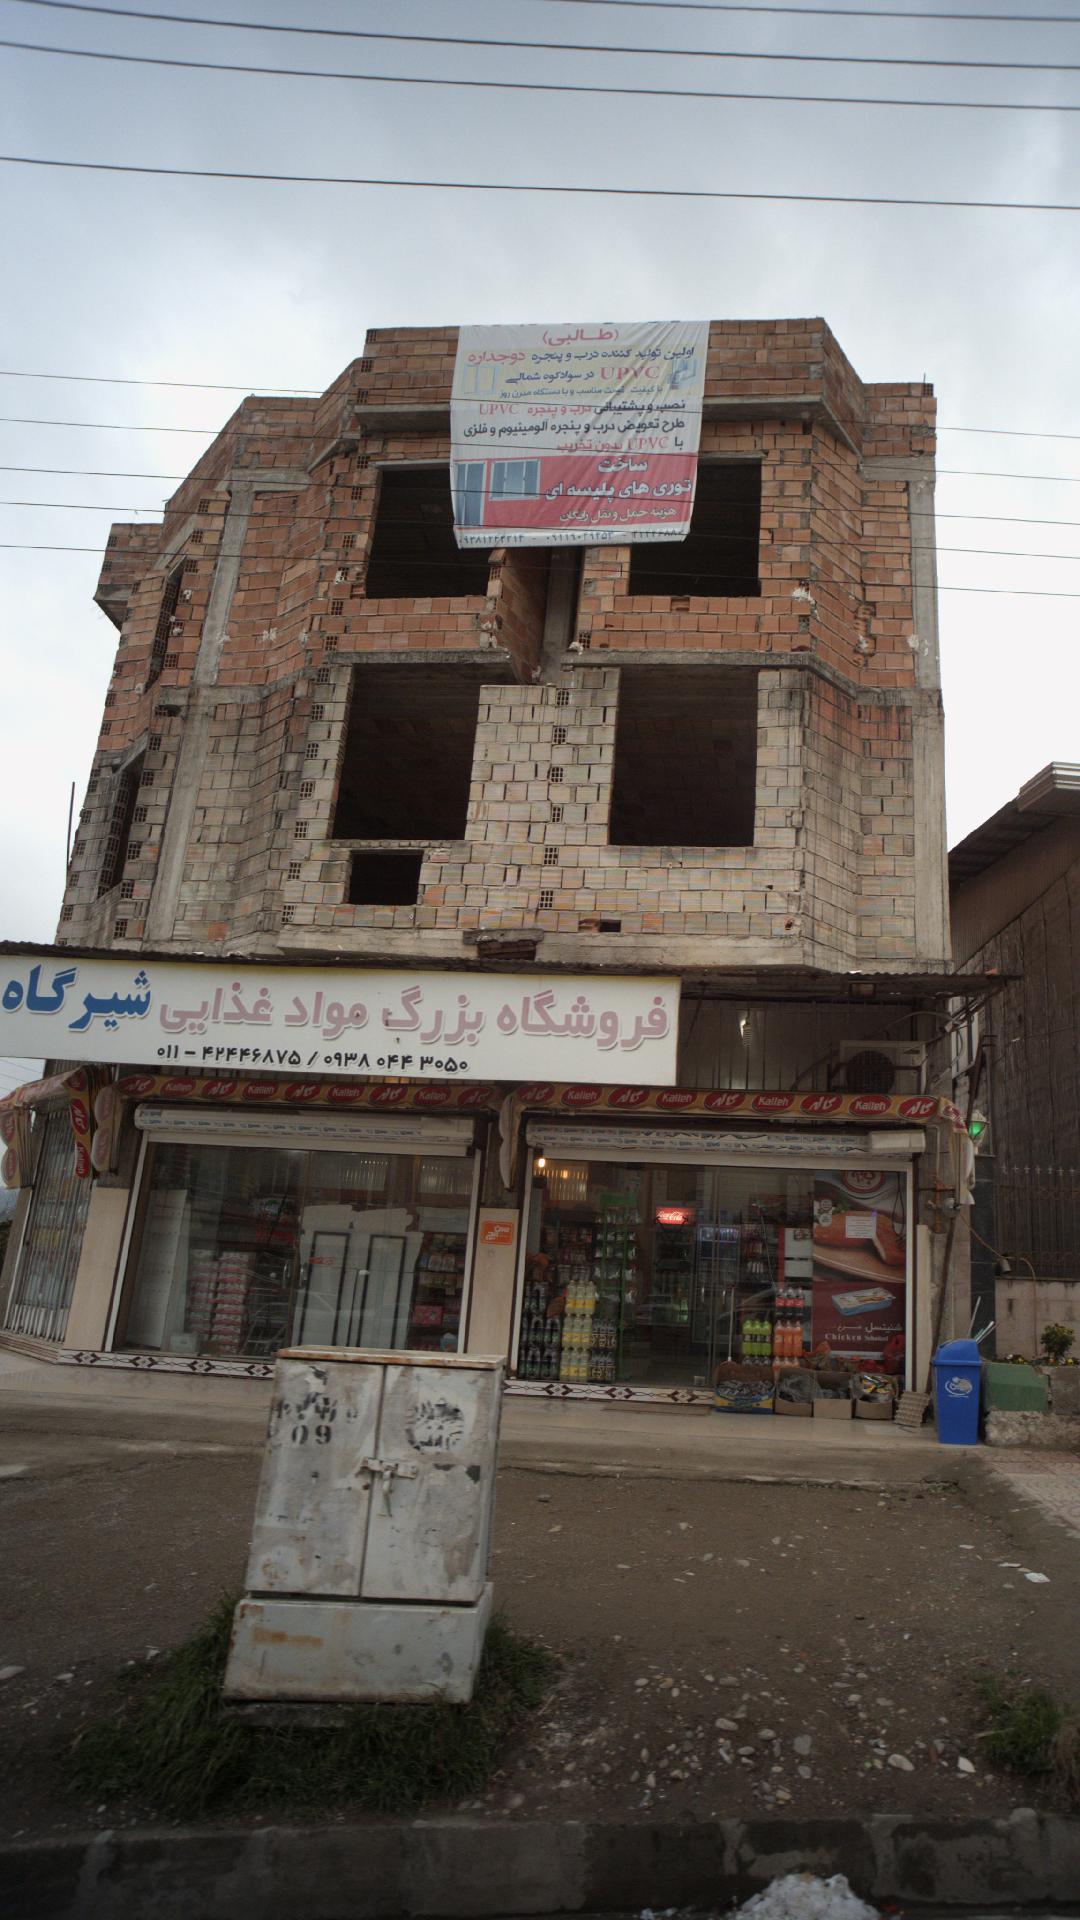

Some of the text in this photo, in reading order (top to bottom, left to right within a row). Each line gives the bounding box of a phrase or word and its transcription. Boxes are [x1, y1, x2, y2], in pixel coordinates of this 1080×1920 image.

[531, 352, 563, 364] پنجره
[574, 350, 599, 361] درب
[601, 349, 632, 360] کننده
[635, 348, 661, 361] تولید
[664, 346, 695, 360] اولین
[600, 366, 660, 382] UPVC
[576, 387, 602, 395] مناسب
[480, 403, 519, 415] UPVC
[527, 406, 558, 418] پنجره
[570, 406, 592, 415] درب
[594, 401, 646, 416] پشتیبانی
[656, 400, 685, 413] نصب
[464, 424, 488, 438] فلزی
[550, 420, 581, 436] پنجره
[592, 423, 615, 433] درب
[617, 418, 660, 433] تعویض
[662, 418, 685, 433] طرح
[675, 437, 684, 450] با
[598, 457, 648, 473] ساخت
[545, 479, 692, 503] توری های پلیسه ای
[591, 508, 612, 523] نقل
[620, 508, 649, 521] حمل
[2, 964, 670, 1051] فروشگاه بزرگ مواد غذایی شیرگاه
[157, 1045, 178, 1057] ۰۱۱
[202, 1046, 301, 1065] ۴۲۴۴۶۸۷۵
[324, 1054, 371, 1068] ۰۹۳۸
[377, 1054, 413, 1069] ۰۴۴
[419, 1056, 468, 1072] ۳۰۵۰
[825, 1333, 862, 1341] Chicken
